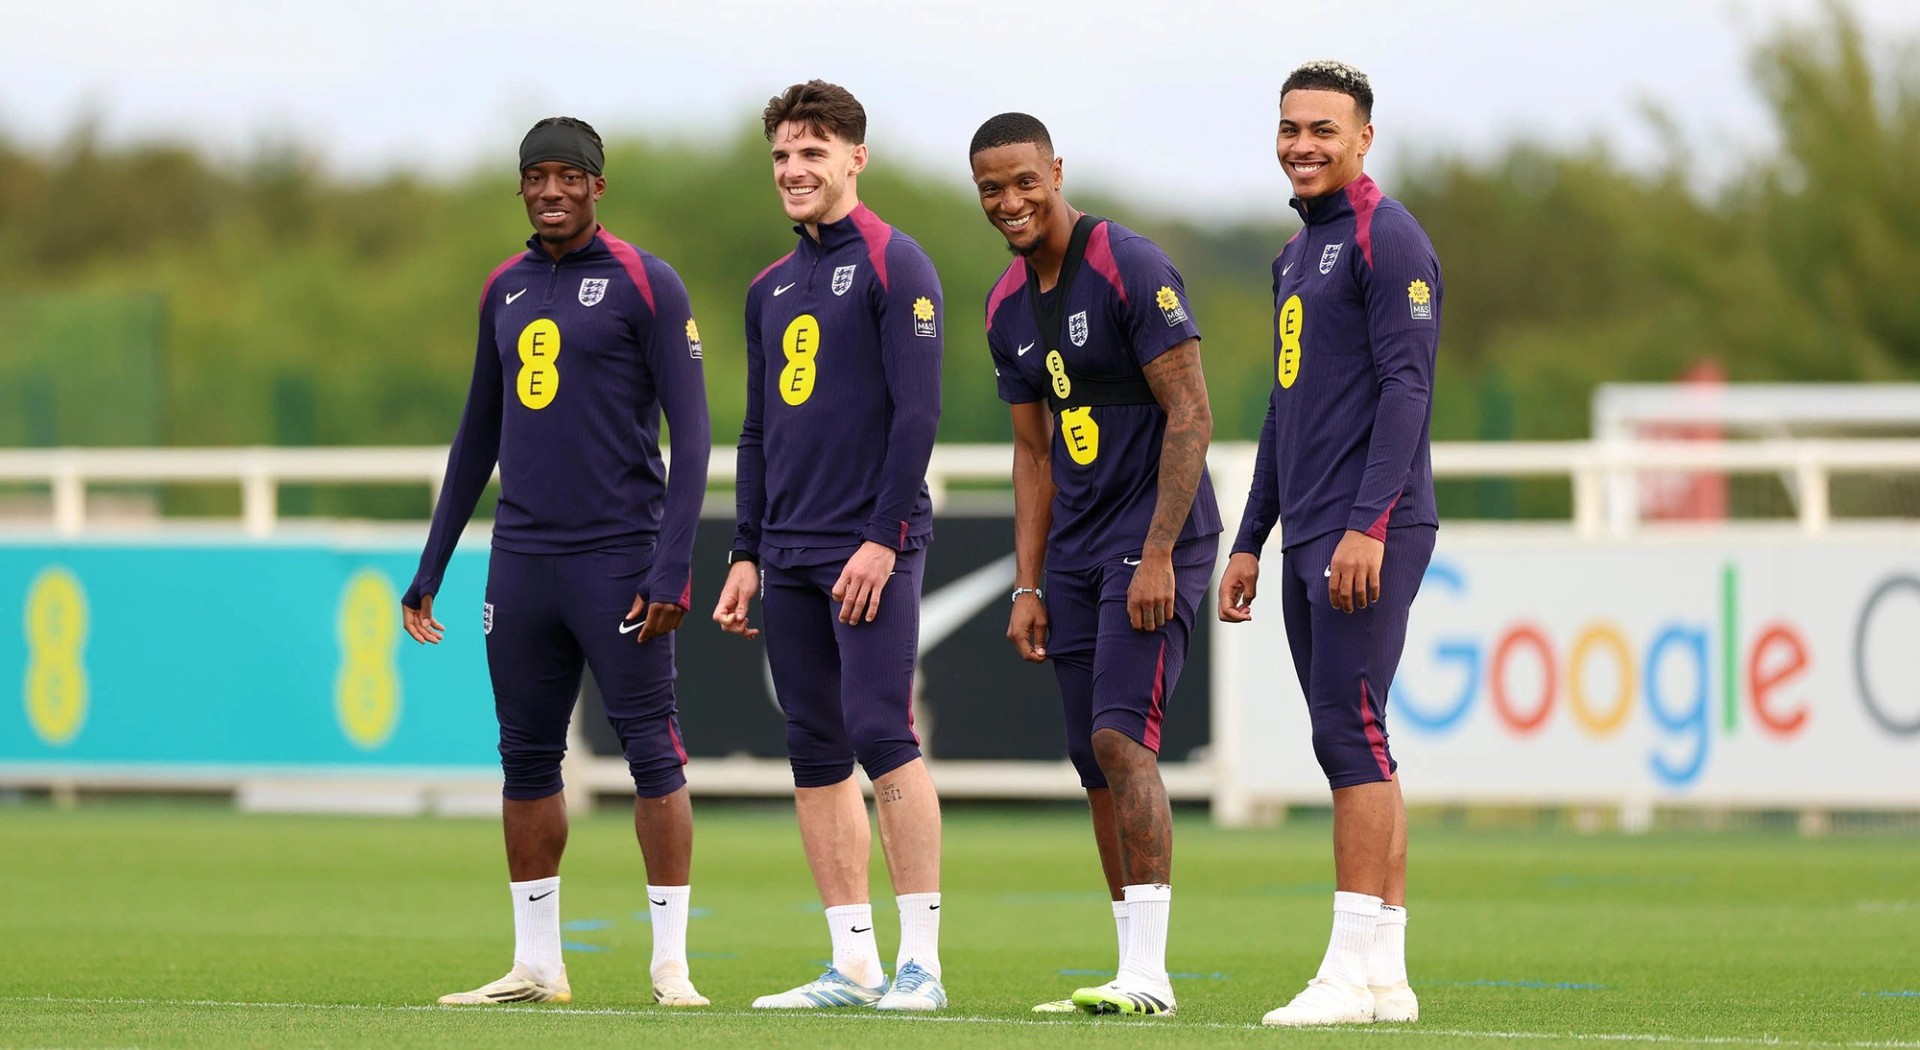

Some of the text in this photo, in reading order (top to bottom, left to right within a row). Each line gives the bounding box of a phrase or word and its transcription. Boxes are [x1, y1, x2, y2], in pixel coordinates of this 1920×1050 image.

[917, 322, 933, 331] M&S
[1167, 308, 1184, 321] M&S
[1413, 305, 1429, 314] M&S
[530, 332, 546, 395] EE
[791, 328, 808, 392] EE
[1051, 356, 1065, 393] EE
[1393, 561, 1809, 784] Google
